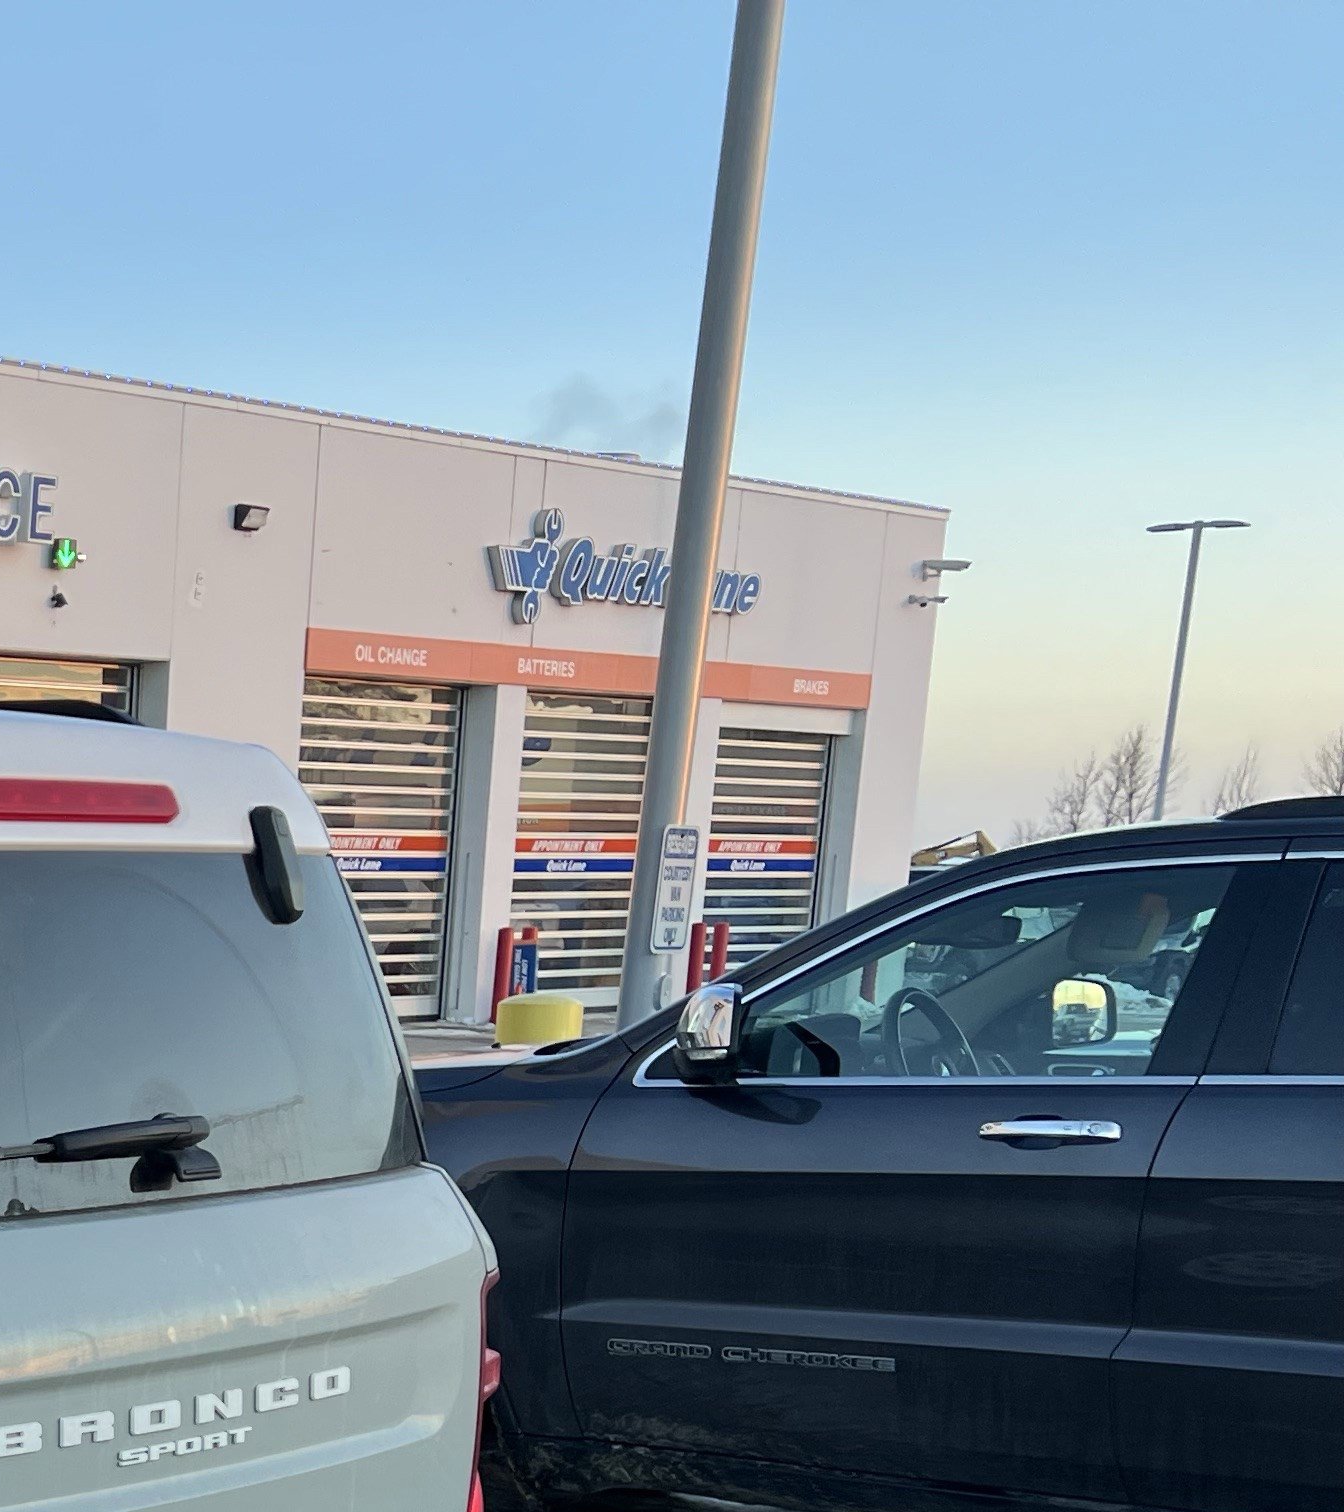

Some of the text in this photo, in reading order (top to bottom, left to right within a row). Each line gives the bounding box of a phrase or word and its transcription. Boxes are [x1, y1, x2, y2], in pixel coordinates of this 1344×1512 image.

[560, 535, 672, 606] Quick
[355, 644, 427, 667] OIL CHANGE
[517, 657, 575, 678] BATTERIES
[793, 678, 830, 696] BRAKES
[378, 837, 403, 850] ONLY
[531, 840, 606, 852] APPOINTMENT ONLY
[717, 841, 764, 852] APPOINTMENT
[336, 857, 382, 871] Quick Lane
[546, 859, 587, 873] Quick Lane
[607, 1337, 896, 1372] GRAND CHEROKEE
[116, 1425, 253, 1467] SPORT
